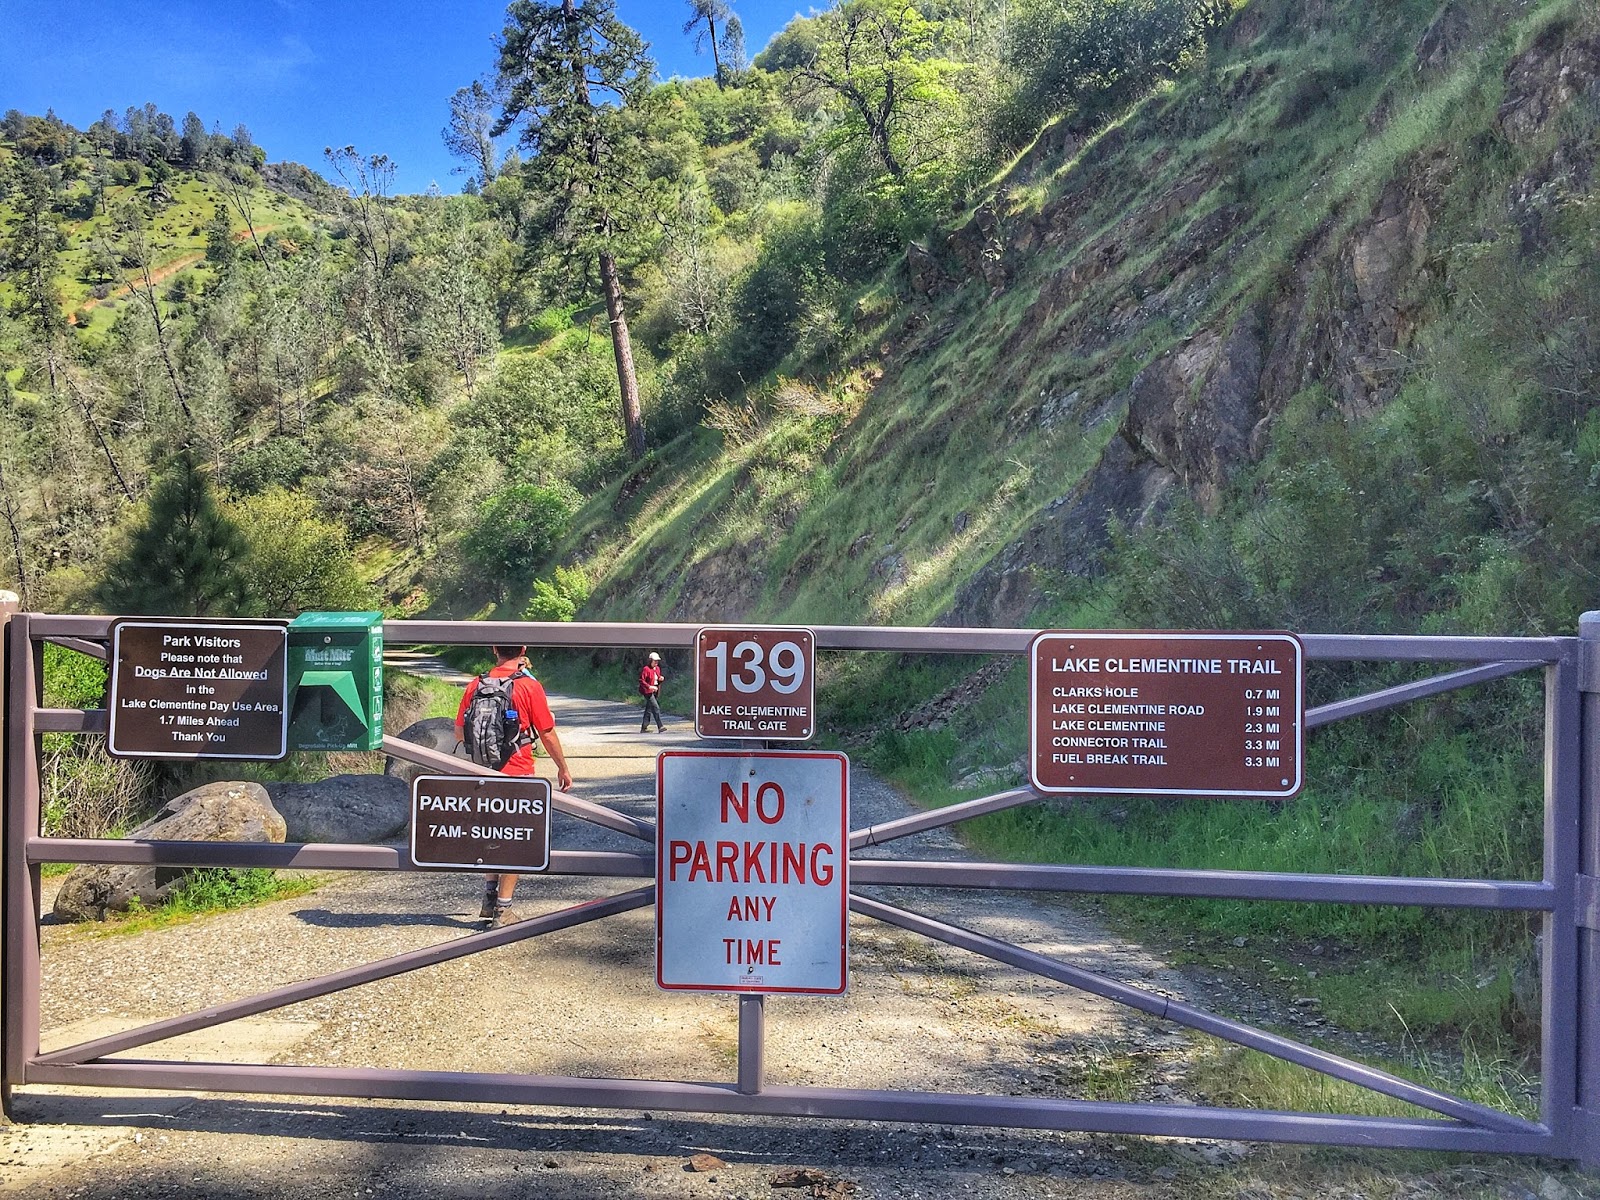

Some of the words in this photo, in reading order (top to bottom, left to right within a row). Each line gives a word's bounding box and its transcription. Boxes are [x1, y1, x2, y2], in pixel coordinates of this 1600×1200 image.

[163, 635, 191, 647] Park
[194, 636, 241, 648] Visitors
[160, 652, 195, 663] Please
[197, 654, 220, 664] note
[222, 653, 243, 664] that
[705, 640, 805, 695] 139
[1052, 658, 1100, 673] LAKE
[1105, 659, 1222, 674] CLEMENTINE
[1227, 659, 1282, 674] TRAIL
[135, 666, 167, 680] Dogs
[169, 666, 191, 679] Are
[194, 668, 217, 679] Not
[218, 669, 268, 680] Allowed
[186, 684, 197, 695] in
[198, 685, 215, 695] the
[1052, 687, 1102, 698] CLARKS
[1105, 687, 1139, 698] HOLE
[1245, 689, 1263, 700] 0.7
[1265, 689, 1280, 700] MI
[122, 699, 147, 709] Lake
[149, 700, 207, 710] Clementine
[209, 702, 230, 713] Day
[232, 702, 252, 712] Use
[254, 703, 279, 712] Area
[702, 705, 732, 715] LAKE
[736, 706, 807, 717] CLEMENTINE
[1052, 704, 1085, 714] LAKE
[1087, 704, 1166, 715] CLEMENTINE
[1168, 705, 1205, 716] ROAD
[1247, 706, 1263, 717] 1.9
[1265, 706, 1280, 717] MI
[159, 715, 175, 725] 1.7
[177, 715, 204, 726] Miles
[206, 717, 240, 727] Ahead
[723, 720, 754, 730] TRAIL
[758, 721, 787, 731] GATE
[1052, 720, 1085, 731] LAKE
[1087, 720, 1166, 732] CLEMENTINE
[1245, 723, 1263, 733] 2.3
[1265, 723, 1280, 733] MI
[172, 731, 204, 742] Thank
[206, 732, 226, 742] You
[1052, 737, 1129, 748] CONNECTOR
[1131, 738, 1168, 749] TRAIL
[1245, 740, 1263, 750] 3.3
[1265, 740, 1280, 750] MI
[1052, 753, 1084, 764] FUEL
[1086, 754, 1129, 765] BREAK
[1131, 754, 1168, 765] TRAIL
[1245, 757, 1263, 767] 3.3
[1265, 757, 1280, 767] MI
[419, 795, 472, 812] PARK
[476, 797, 544, 815] HOURS
[720, 781, 785, 825] NO
[428, 824, 468, 838] 7AM-
[470, 826, 534, 841] SUNSET
[669, 840, 834, 887] PARKING
[727, 896, 777, 922] ANY
[722, 938, 782, 966] TIME
